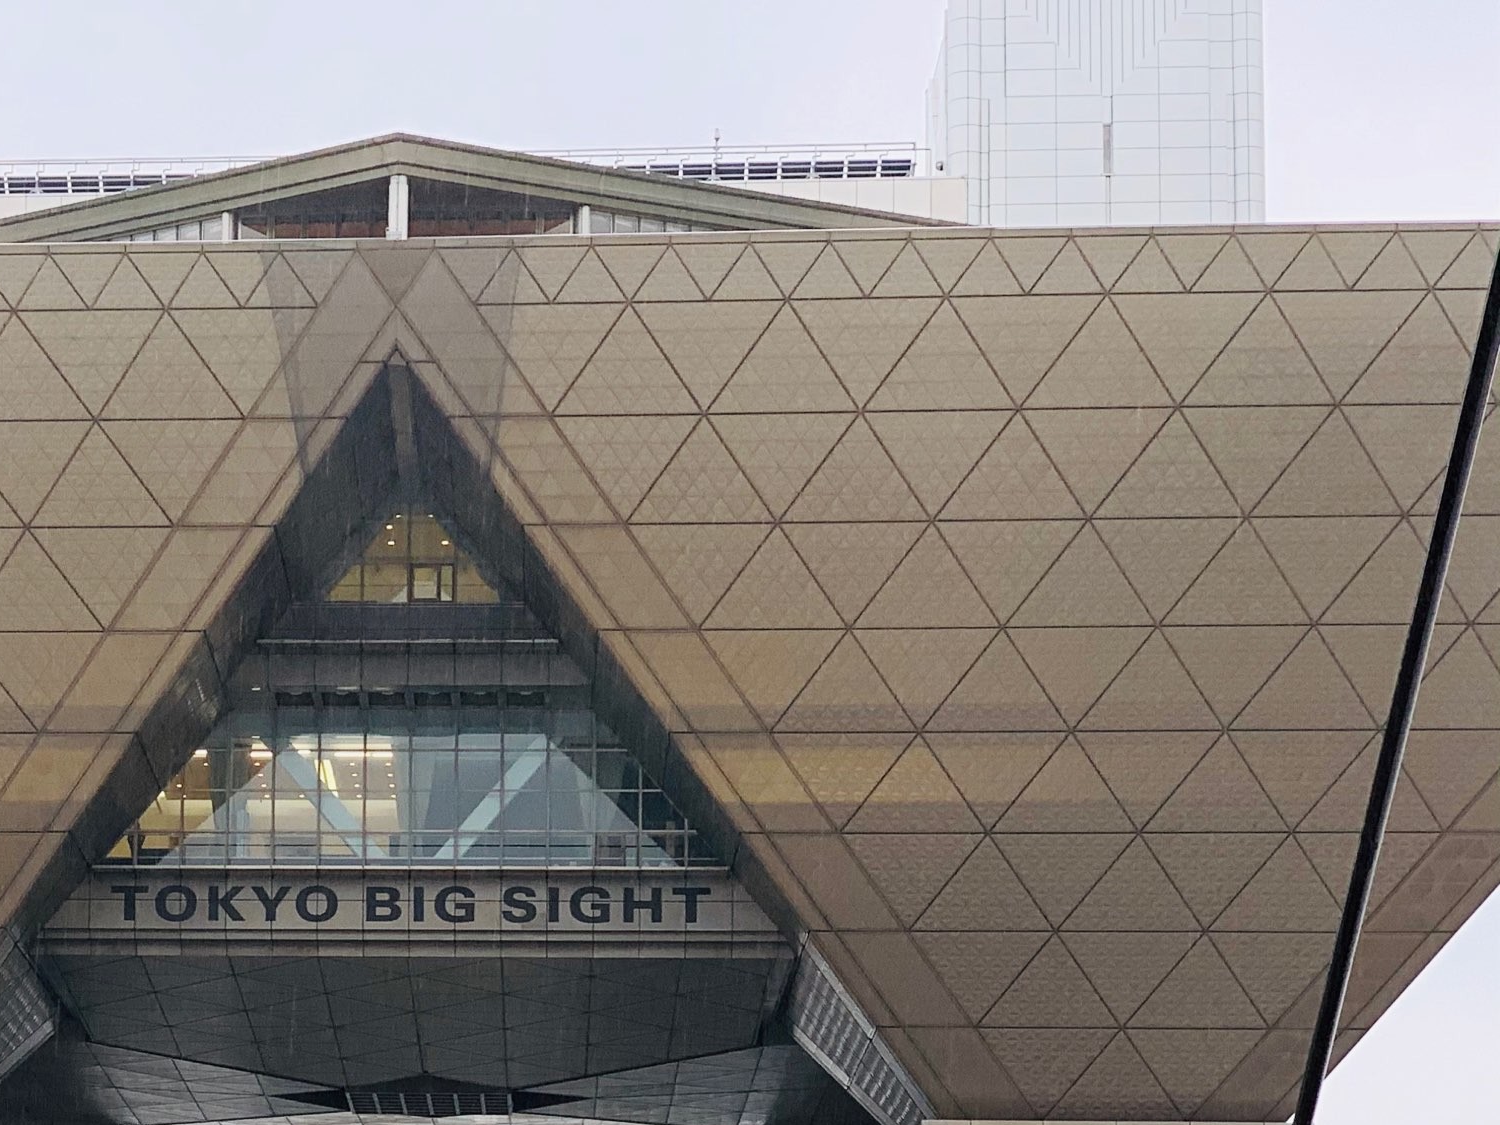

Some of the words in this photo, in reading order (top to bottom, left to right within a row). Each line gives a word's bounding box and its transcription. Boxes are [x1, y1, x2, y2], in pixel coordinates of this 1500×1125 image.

[111, 884, 339, 924] TOKYO
[364, 885, 477, 924] BIG
[501, 885, 712, 924] SIGHT
